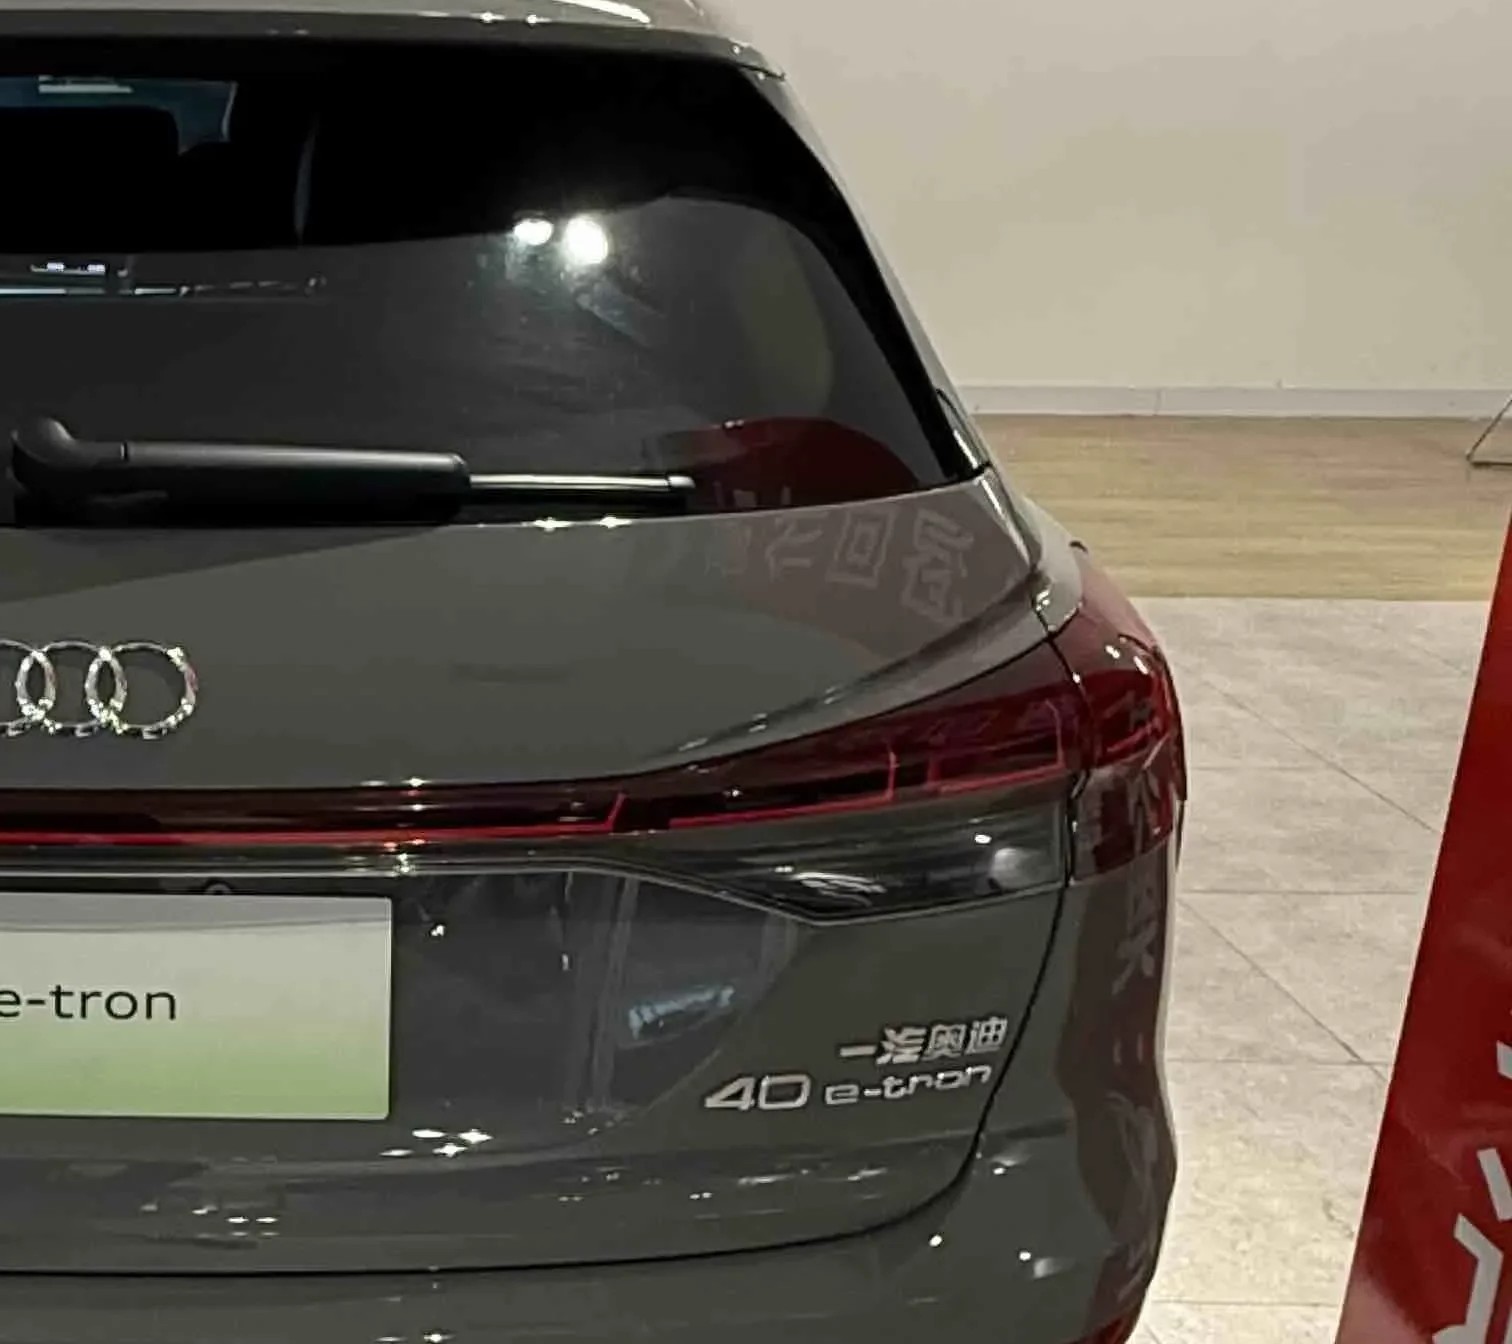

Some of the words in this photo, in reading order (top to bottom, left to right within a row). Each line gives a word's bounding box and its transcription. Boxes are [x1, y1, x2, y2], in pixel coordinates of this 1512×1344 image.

[839, 1016, 1008, 1065] 一汽奥迪
[704, 1074, 811, 1111] 40
[824, 1064, 992, 1106] e-tron
